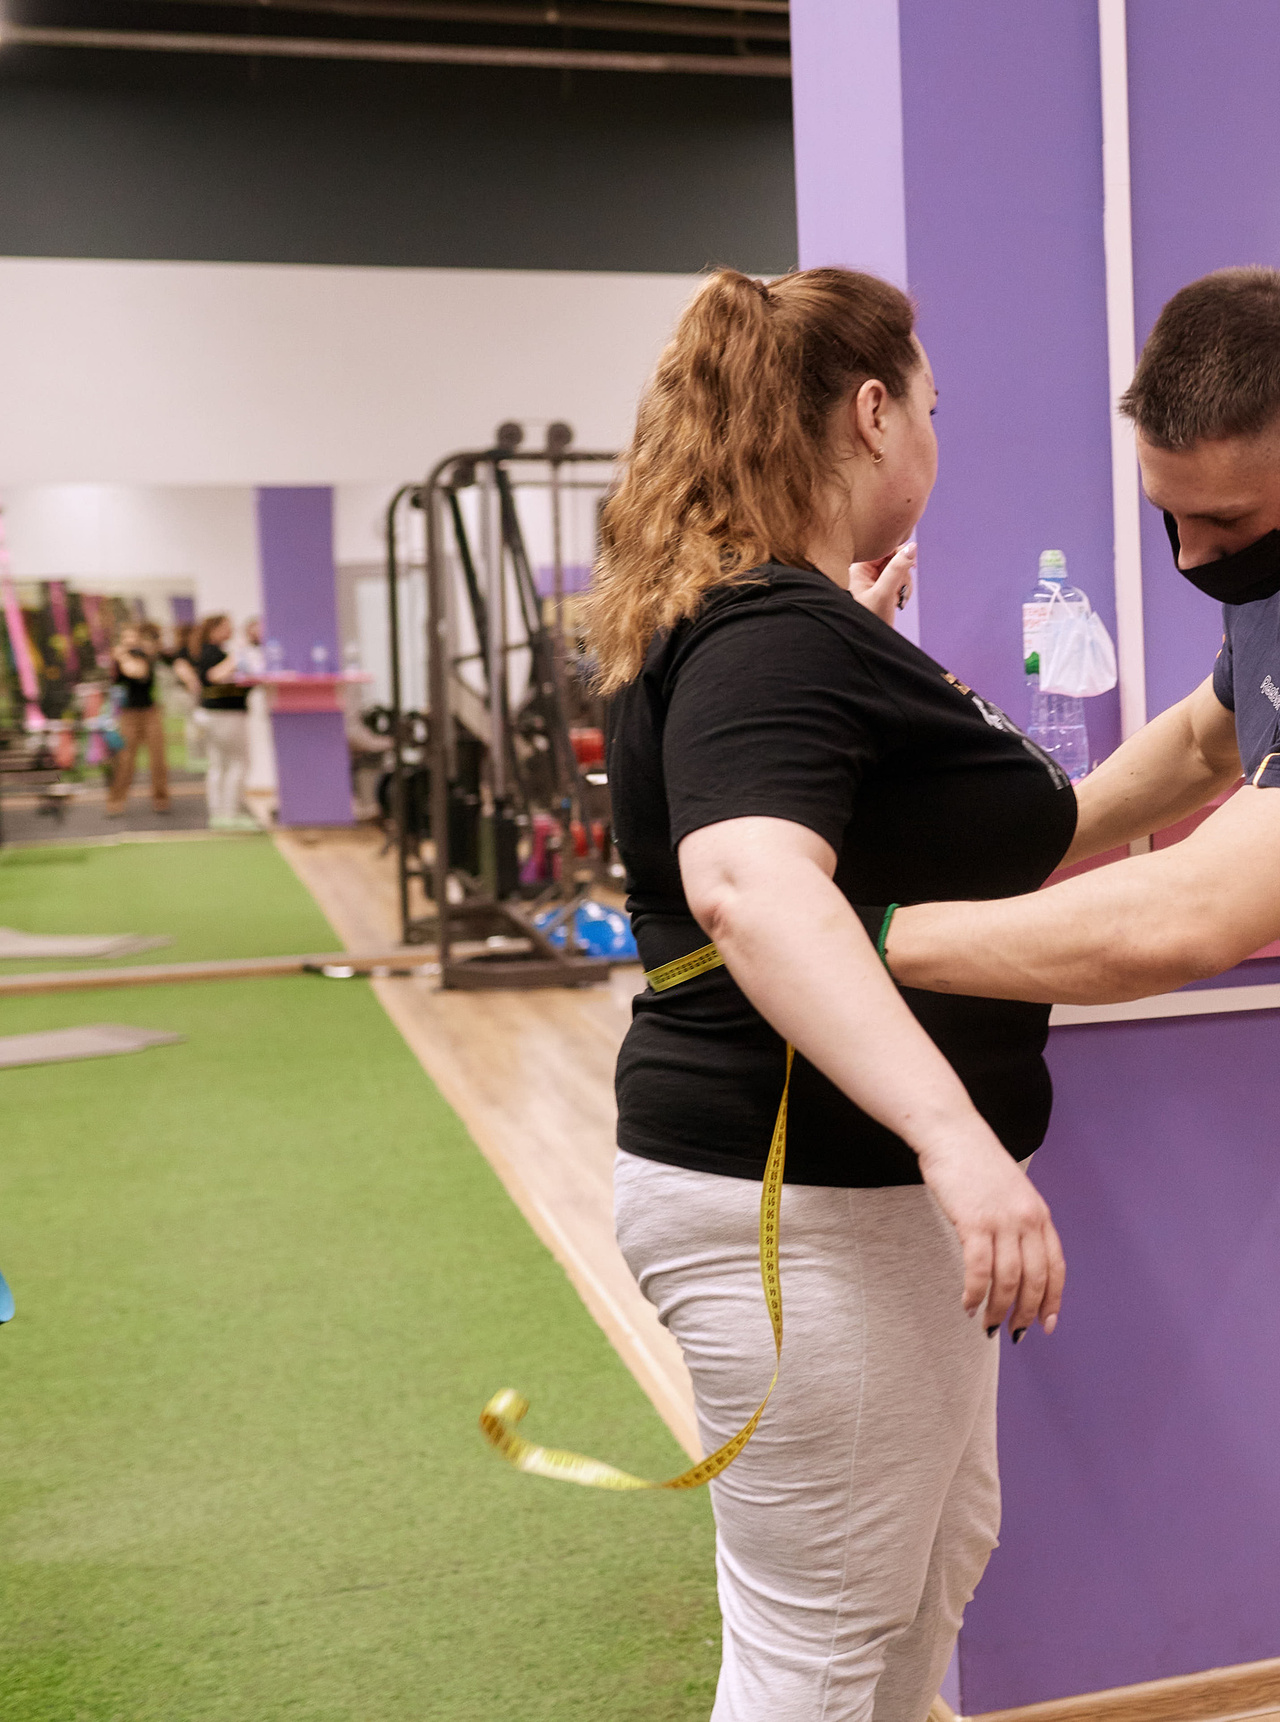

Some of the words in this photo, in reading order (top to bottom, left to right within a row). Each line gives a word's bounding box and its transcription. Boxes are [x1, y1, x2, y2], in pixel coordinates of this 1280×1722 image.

[768, 1184, 776, 1194] 52
[768, 1197, 775, 1207] 51
[766, 1209, 774, 1220] 50
[766, 1249, 773, 1258] 47
